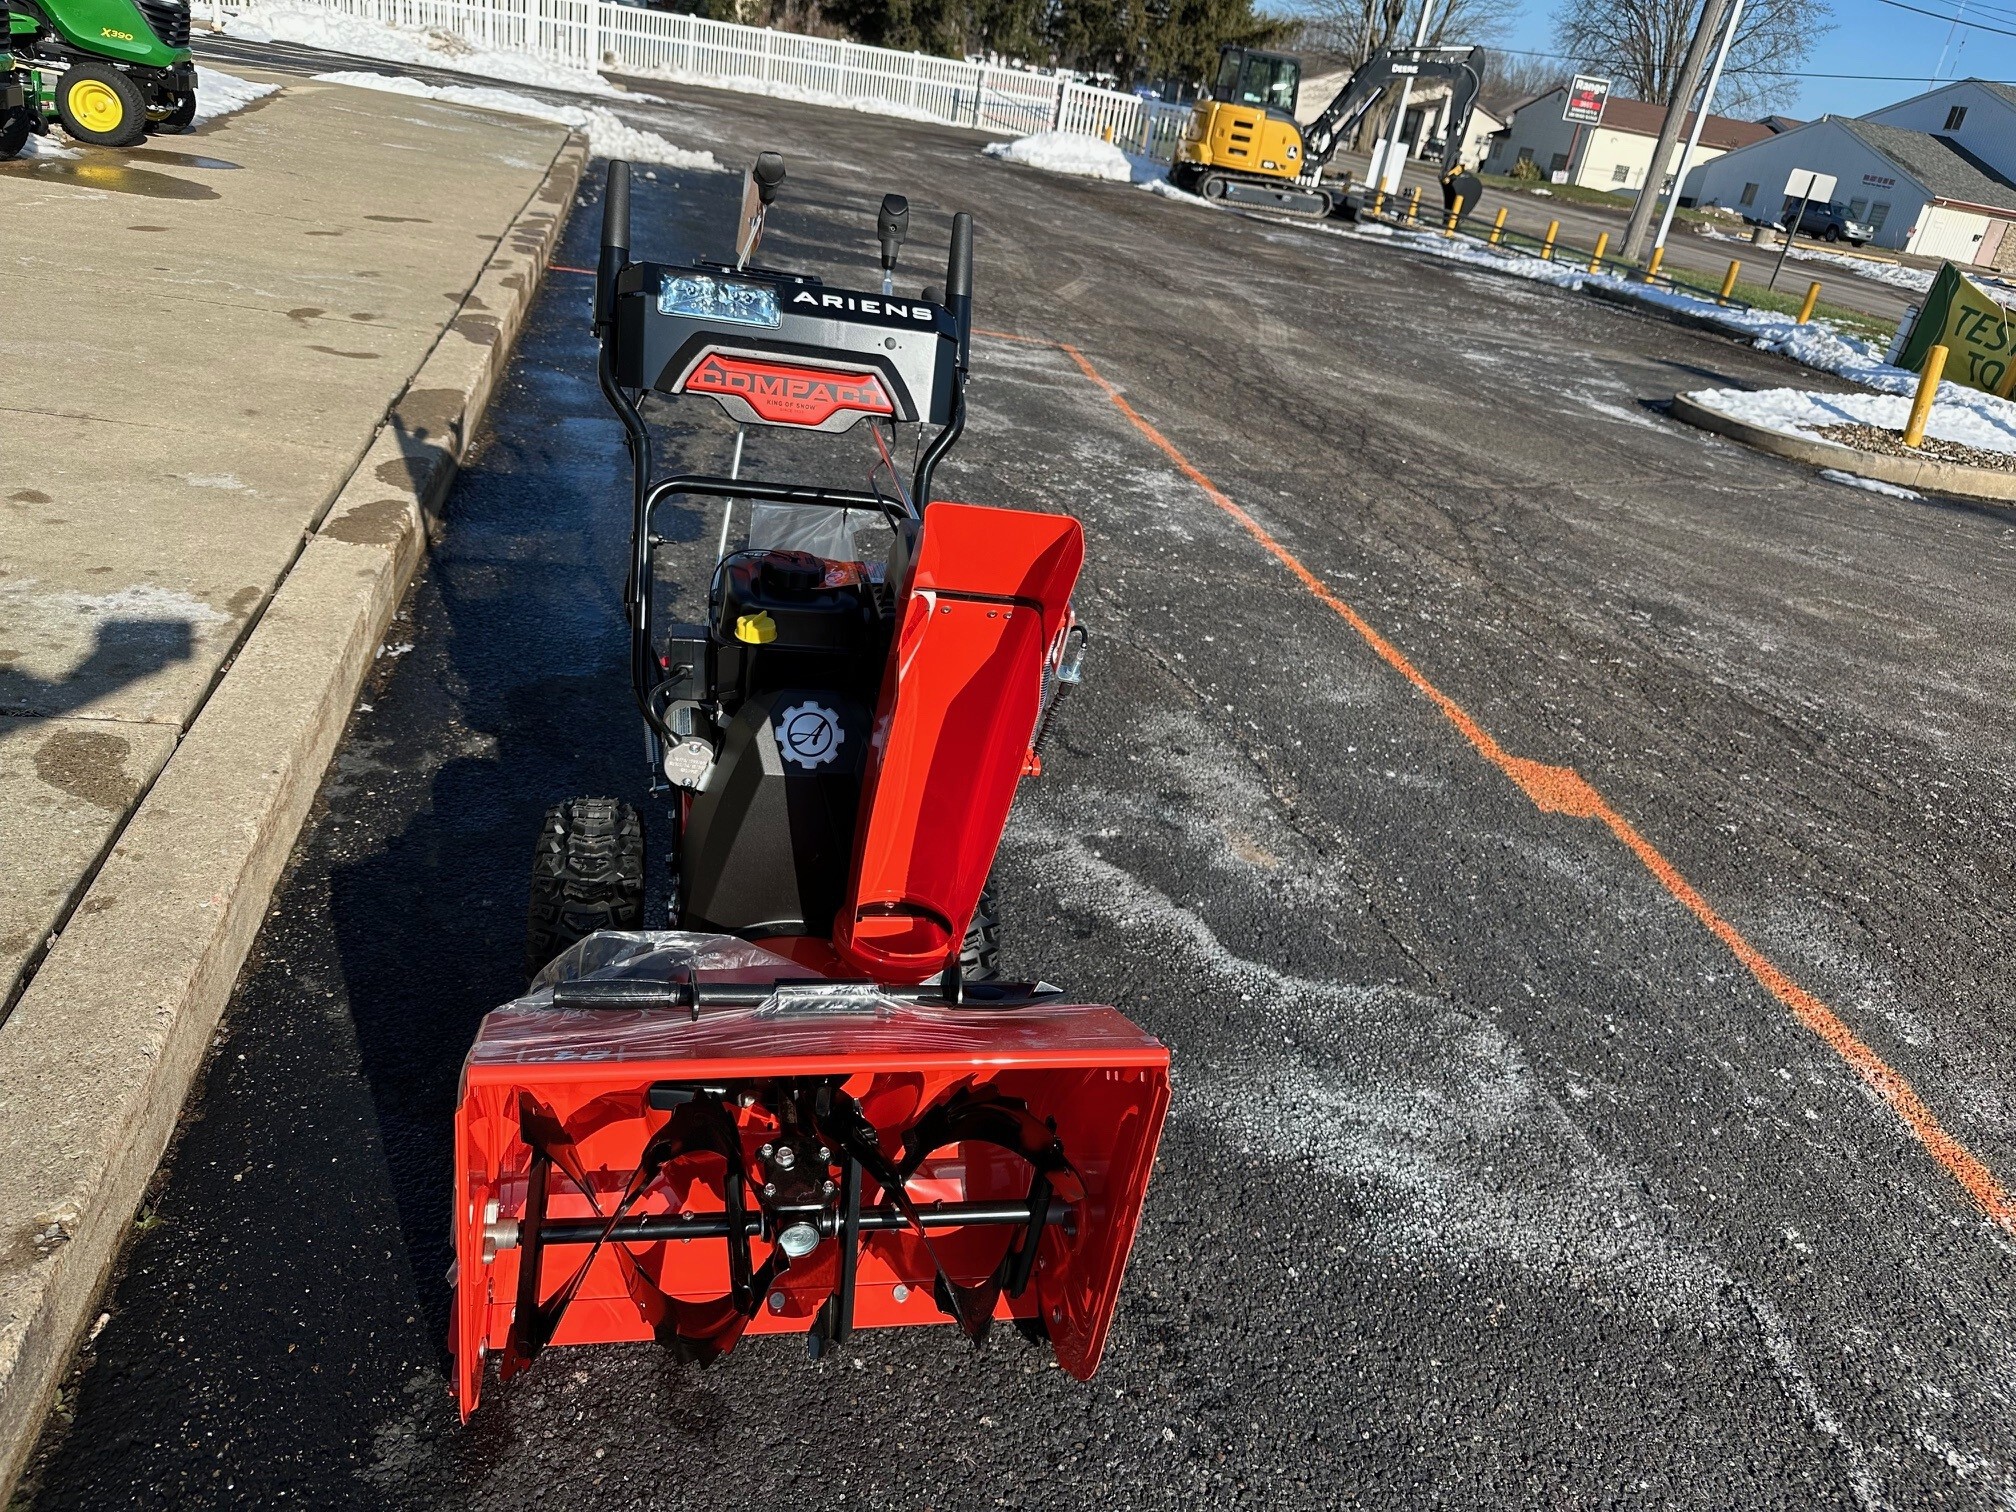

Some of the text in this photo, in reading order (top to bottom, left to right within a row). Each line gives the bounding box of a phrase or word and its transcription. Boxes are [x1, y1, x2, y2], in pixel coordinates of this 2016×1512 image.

[100, 27, 134, 41] X390
[1575, 79, 1607, 95] Range
[793, 291, 933, 321] ARIENS
[1954, 304, 2016, 357] TES
[1967, 350, 2006, 391] TO
[700, 367, 887, 405] COMPACT
[766, 399, 783, 407] KING
